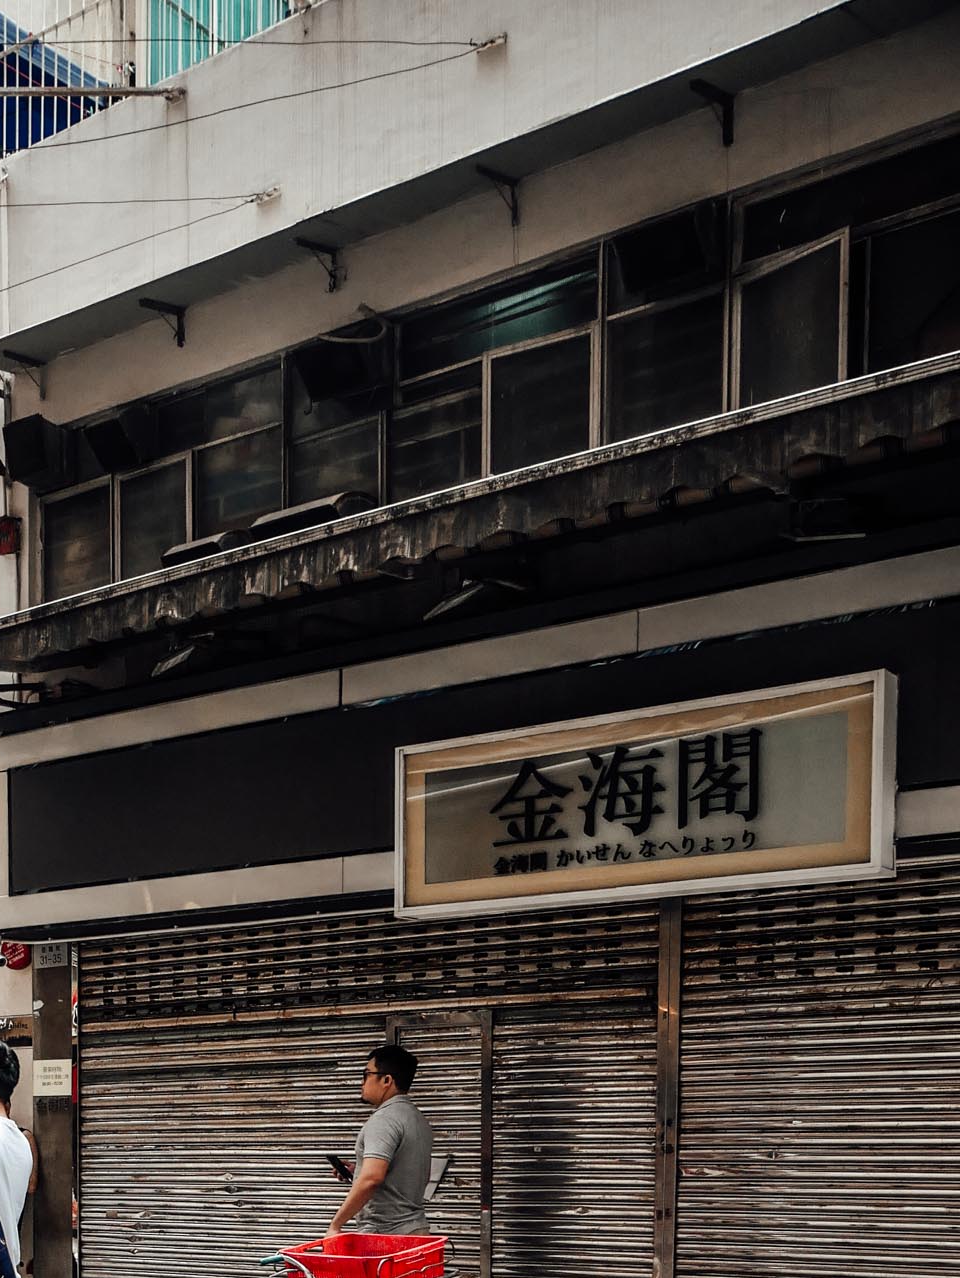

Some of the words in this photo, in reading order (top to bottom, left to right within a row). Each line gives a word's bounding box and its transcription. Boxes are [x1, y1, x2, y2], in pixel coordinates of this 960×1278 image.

[490, 727, 763, 847] 金海閣
[556, 843, 632, 867] かいせん
[40, 953, 62, 966] 31-35
